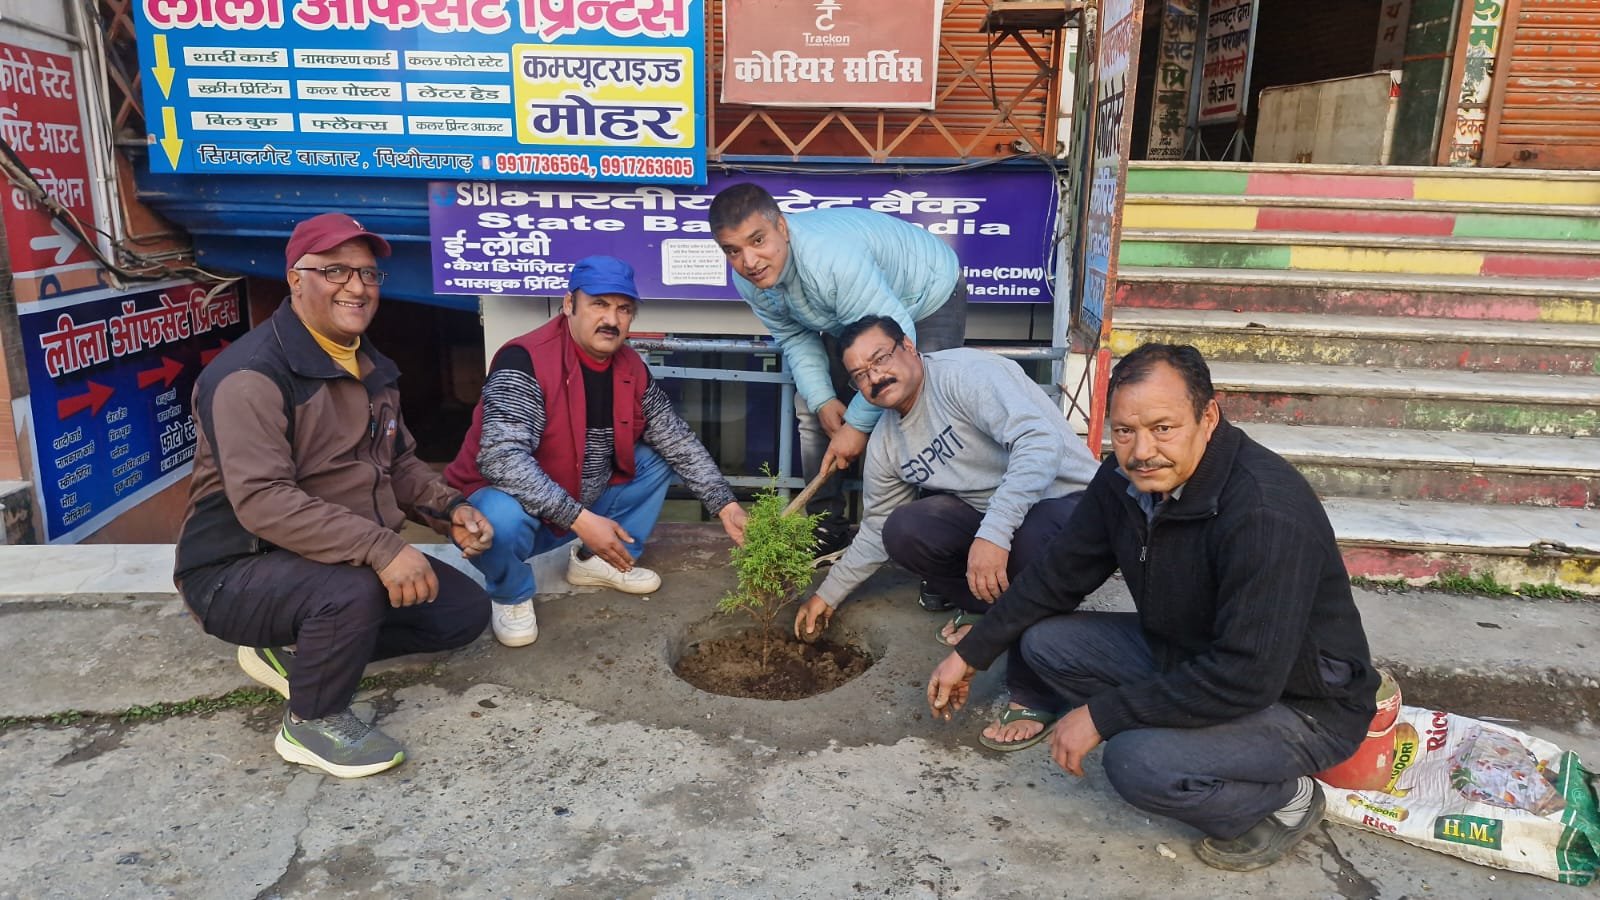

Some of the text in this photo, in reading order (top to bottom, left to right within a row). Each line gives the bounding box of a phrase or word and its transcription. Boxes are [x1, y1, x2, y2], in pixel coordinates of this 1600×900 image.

[802, 32, 850, 43] Trackon
[193, 49, 280, 63] शादी कार्ड
[301, 52, 392, 66] नामकरण कार्ड
[407, 54, 504, 68] कलर फोटो स्टेट
[733, 50, 923, 83] कोरियर सर्विस
[37, 57, 73, 100] स्टेट
[522, 55, 682, 88] कम्प्यूटराइज्ड
[197, 81, 238, 95] स्क्रीन
[306, 83, 391, 97] कलर पोस्टर
[418, 85, 500, 101] लेटर हेड
[206, 113, 278, 129] बिल बुक
[415, 121, 444, 130] कलर
[445, 118, 470, 131] प्रिन्ट
[532, 94, 683, 140] मोहर
[37, 122, 80, 154] आउट
[197, 144, 292, 166] सिमलगैर
[373, 147, 475, 173] पिथौरागढ़
[600, 155, 695, 178] 9917263605
[456, 182, 498, 206] SBI
[868, 190, 987, 215] बैंक
[477, 212, 1011, 235] State Ba dia
[441, 229, 552, 258] ई-लॉबी
[454, 278, 522, 293] पासबुक
[39, 313, 109, 379] लीला
[110, 294, 190, 357] ऑफसेट
[184, 417, 197, 440] स्टे
[900, 424, 964, 483] ESPRIT
[1362, 814, 1397, 833] Rice
